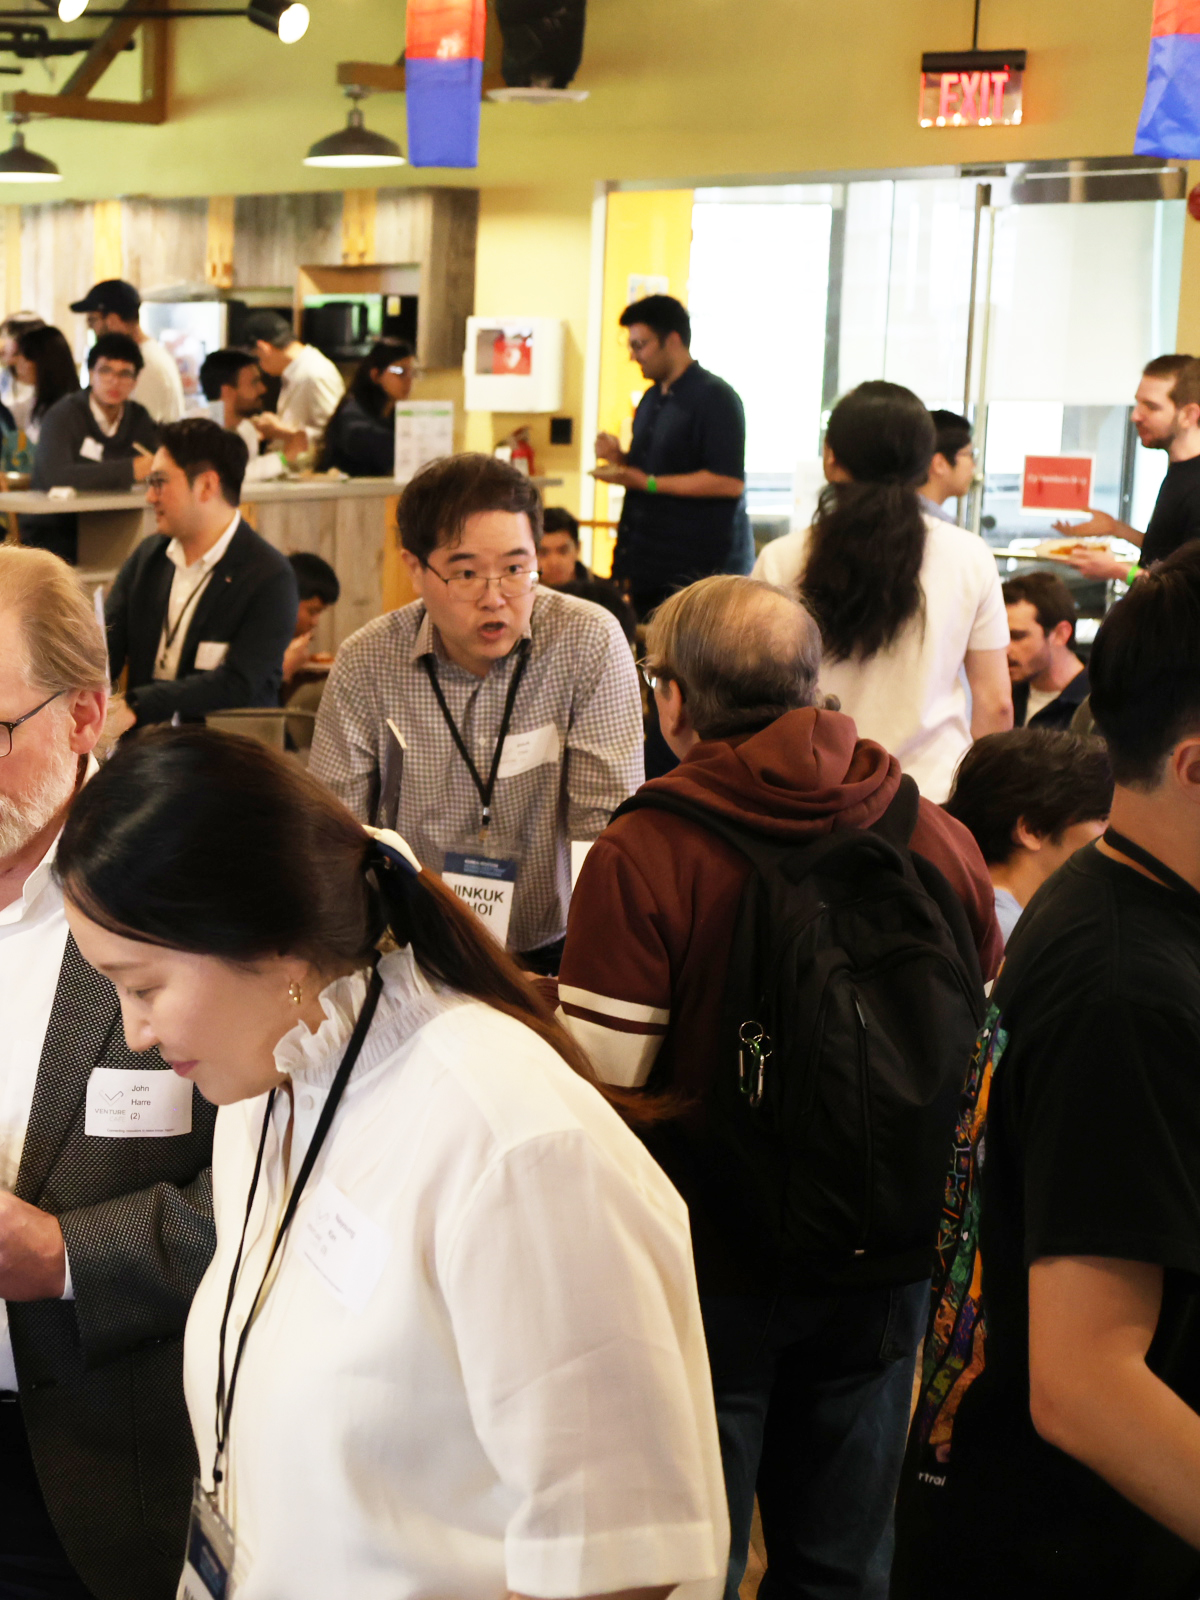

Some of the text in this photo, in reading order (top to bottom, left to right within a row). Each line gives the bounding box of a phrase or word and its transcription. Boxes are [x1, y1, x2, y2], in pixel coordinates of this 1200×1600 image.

[939, 71, 1010, 120] EXIT
[467, 901, 493, 916] HOI
[130, 1112, 141, 1120] (2)
